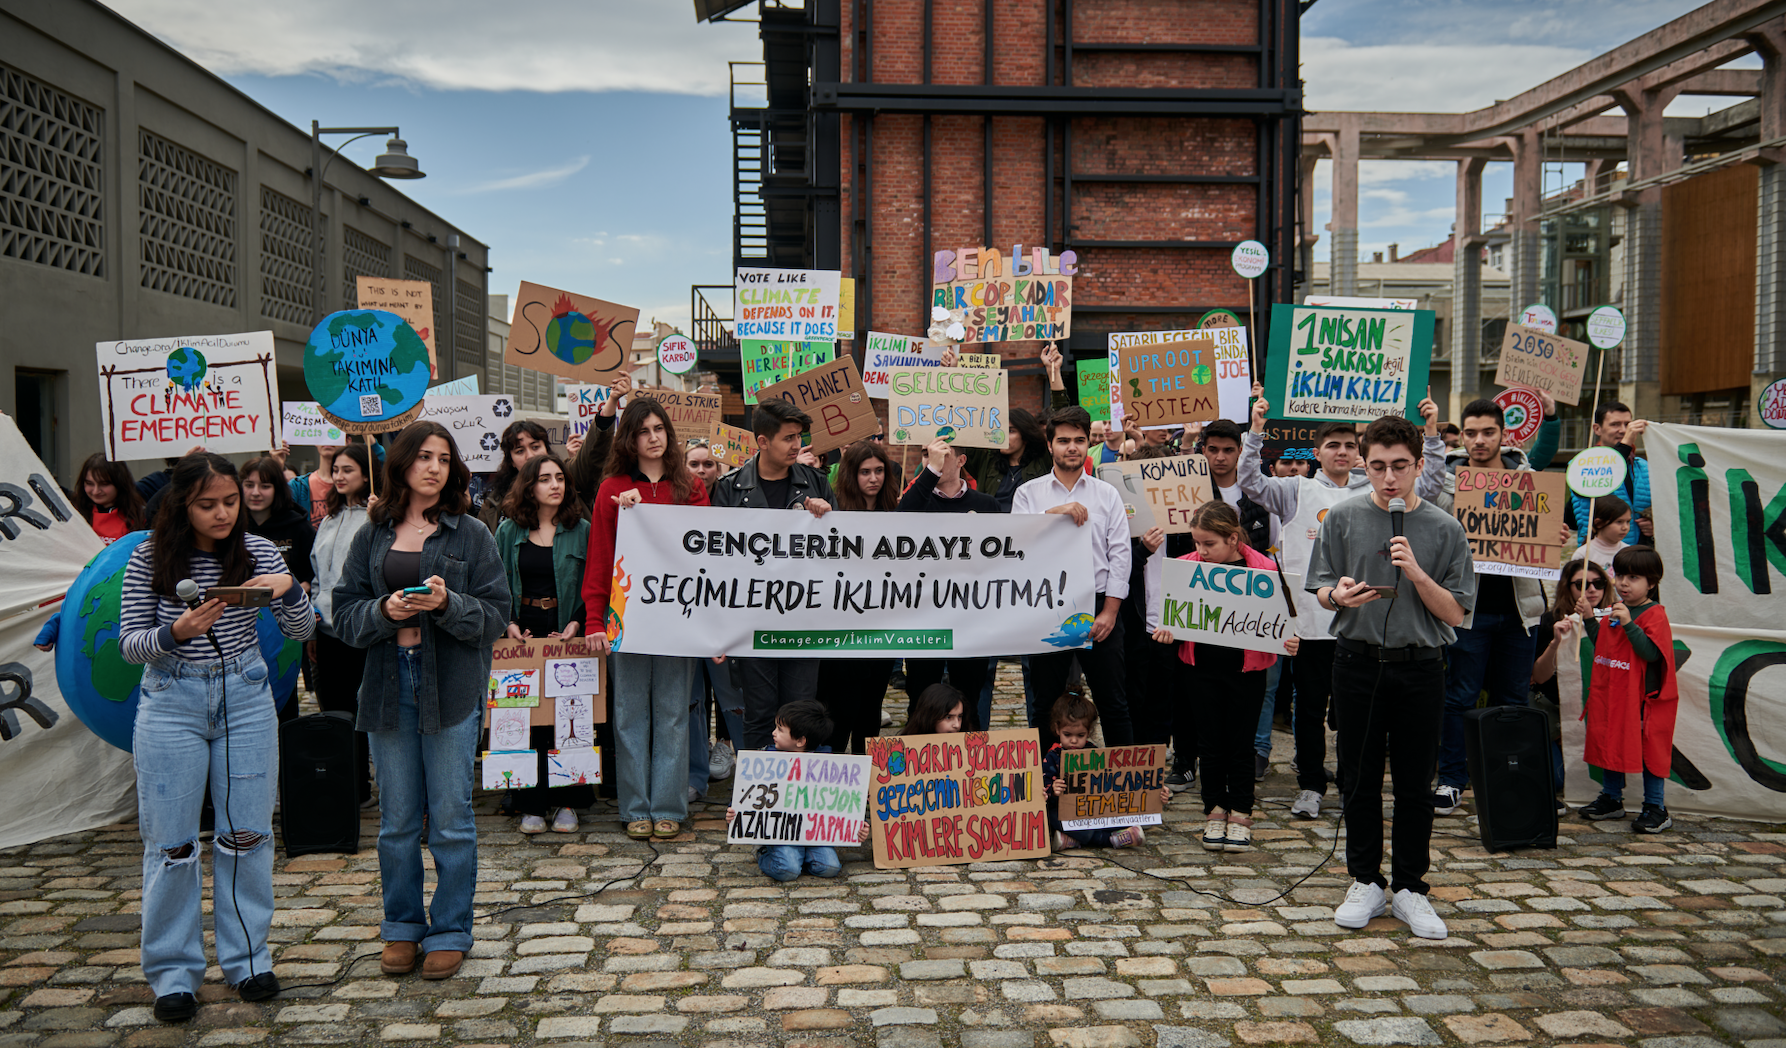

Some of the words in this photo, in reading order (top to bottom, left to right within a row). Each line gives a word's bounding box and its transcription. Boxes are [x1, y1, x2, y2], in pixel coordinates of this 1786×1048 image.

[739, 273, 770, 283] VOTE
[777, 273, 806, 283] LIKE
[367, 286, 385, 295] THIS
[391, 288, 398, 296] IS
[739, 287, 821, 305] CLIMATE
[934, 282, 967, 310] BİR
[1015, 280, 1070, 308] KADAR
[743, 306, 793, 320] DEPENDS
[799, 306, 815, 318] ON
[821, 305, 835, 319] IT,
[972, 306, 1062, 325] SEYAHAT
[331, 327, 378, 349] DÜNYA
[738, 322, 785, 336] BECAUSE
[791, 322, 801, 335] IT
[805, 322, 834, 336] DOES
[956, 321, 1064, 343] DEMİYORUM
[1219, 328, 1239, 344] BİR
[1297, 313, 1320, 355] 1
[1319, 314, 1386, 350] NİSAN
[663, 341, 687, 352] SIFIR
[869, 335, 908, 353] İKLİMİ
[911, 341, 924, 354] DE
[1512, 332, 1554, 359] 2050
[328, 356, 400, 377] TAKIMINA
[662, 352, 695, 363] KARBON
[746, 356, 795, 374] HERKES
[799, 351, 825, 368] İÇİN
[985, 356, 996, 364] BU
[1128, 349, 1202, 373] UPROOT
[1320, 347, 1384, 375] ŞAKASI
[1219, 359, 1248, 379] JOE
[121, 376, 160, 389] There
[231, 375, 242, 385] a
[348, 378, 388, 393] KATIL
[797, 366, 851, 406] PLANET
[892, 371, 1002, 395] GELECEĞİ
[1148, 375, 1185, 393] THE
[1291, 360, 1344, 400] İKLİM
[1345, 376, 1402, 403] KRİZİ
[130, 390, 243, 416] CLIMATE
[685, 395, 719, 408] STRIKE
[1131, 397, 1213, 421] SYSTEM
[1289, 399, 1320, 415] Kadere
[121, 414, 259, 442] EMERGENCY
[821, 404, 850, 436] B
[898, 404, 1001, 431] DEĞİŞTİR
[717, 424, 749, 445] İKLİM
[728, 441, 760, 456] HAREKE
[1140, 458, 1207, 481] KÖMÜRÜ
[1578, 455, 1617, 466] ORTAK
[1580, 467, 1612, 476] FAYDA
[1458, 470, 1535, 491] 2030'A
[1582, 476, 1613, 488] İLKESİ
[1146, 484, 1204, 506] TERK
[1484, 491, 1550, 513] KADAR
[1167, 508, 1198, 525] ET
[1457, 505, 1538, 538] KÖMÜRDEN
[683, 527, 864, 565] GENÇLERİN
[872, 535, 972, 560] ADAYI
[980, 535, 1025, 560] OL,
[1189, 563, 1274, 599] ACCIO
[640, 568, 823, 619] SEÇİMLERDE
[833, 571, 927, 614] İKLİMİ
[933, 570, 1067, 610] UNUTMA!
[1163, 593, 1222, 632] İKLİM
[760, 631, 947, 647] Change.org/İklimVaatleri
[492, 643, 534, 660] OCUKTAN
[1065, 750, 1105, 773] İKLİM
[1108, 746, 1156, 768] KRİZİ
[739, 757, 801, 782] 2030'A
[805, 758, 862, 787] KADAR
[1063, 772, 1088, 794] İLE
[1090, 767, 1164, 794] MÜCADELE
[739, 783, 779, 810] %35
[783, 783, 863, 814] EMİSYON
[1076, 790, 1147, 816] ETMELİ
[730, 811, 803, 841] AZALTIMI
[884, 815, 963, 861] KİMLERE
